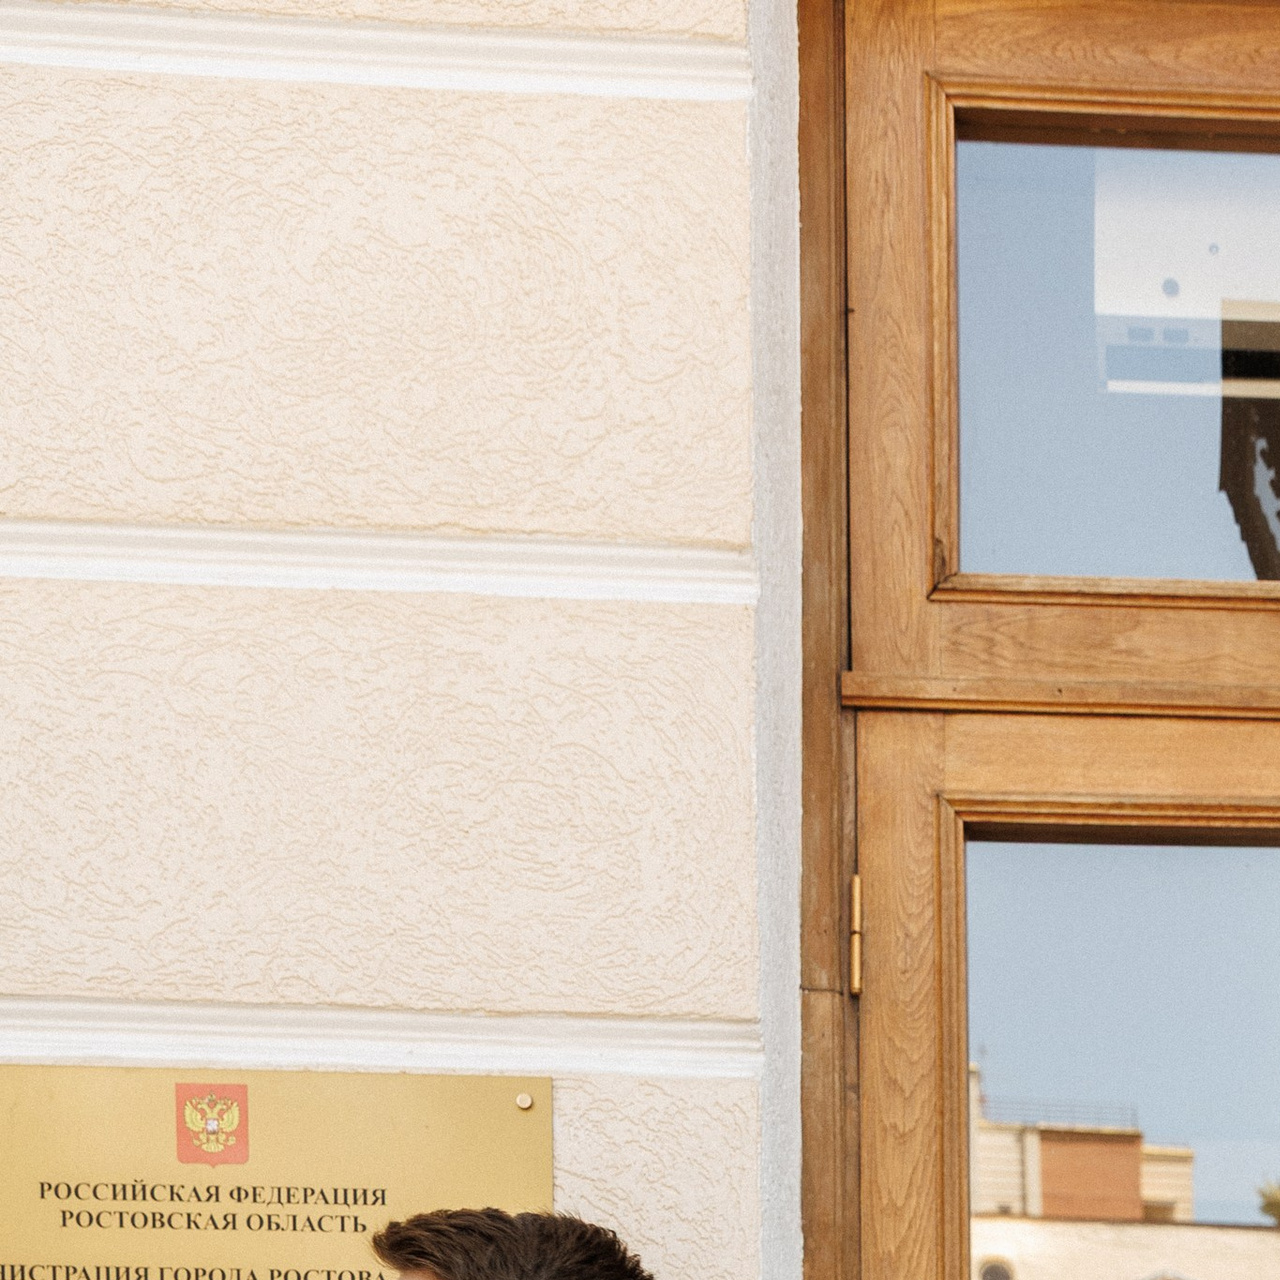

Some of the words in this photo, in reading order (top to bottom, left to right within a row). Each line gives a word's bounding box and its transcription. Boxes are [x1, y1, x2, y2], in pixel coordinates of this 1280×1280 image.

[39, 1179, 220, 1203] РОССИЙСКАЯ
[229, 1185, 387, 1208] ФЕДЕРАЦИЯ
[60, 1210, 237, 1231] РОСТОВСКАЯ
[246, 1213, 367, 1233] ОБЛАСТЬ
